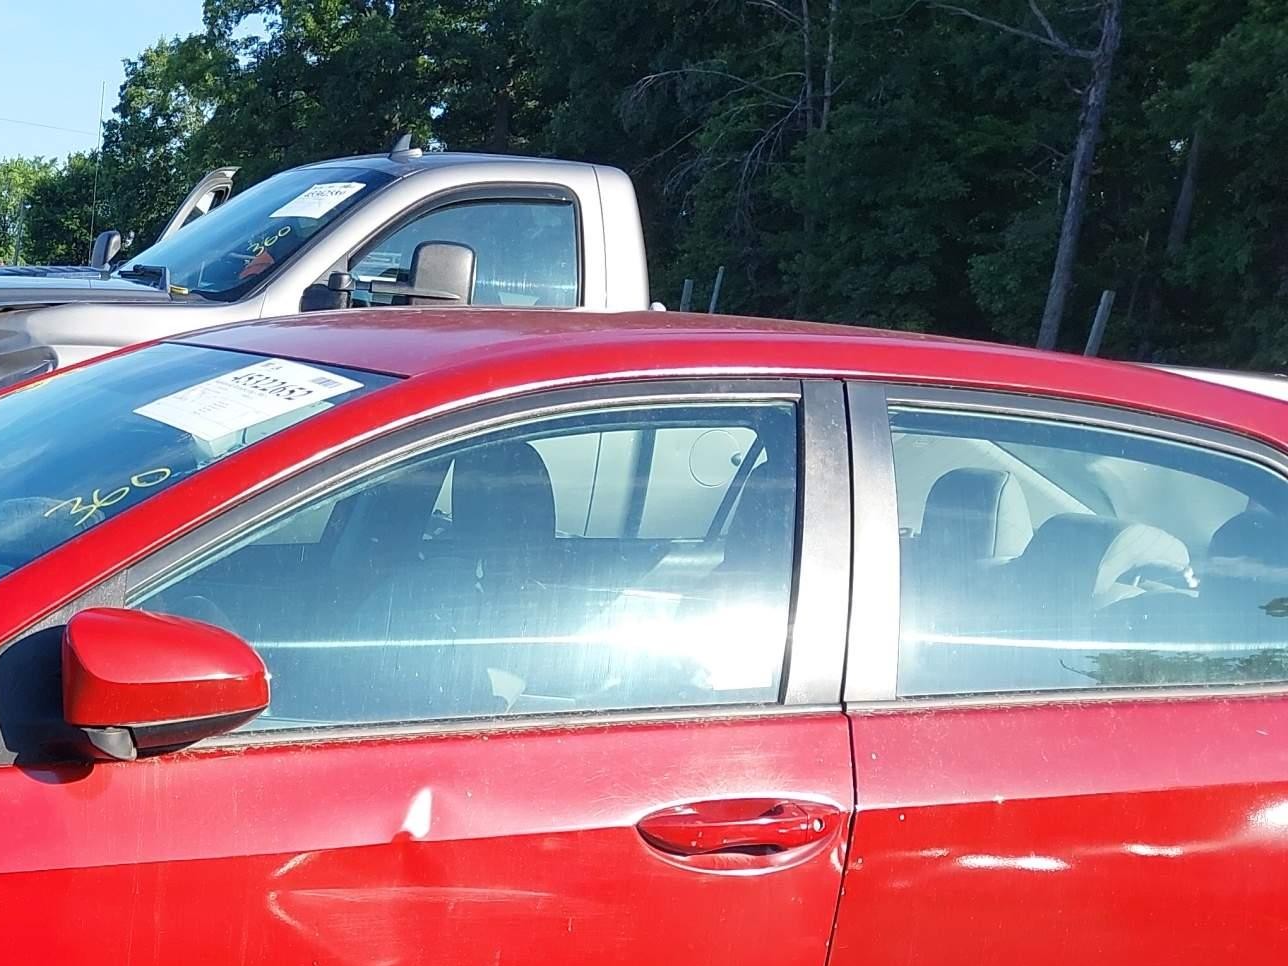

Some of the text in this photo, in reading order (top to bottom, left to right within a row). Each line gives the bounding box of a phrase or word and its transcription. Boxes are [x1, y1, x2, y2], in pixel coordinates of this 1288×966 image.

[245, 225, 292, 257] 360
[231, 372, 314, 401] 45322652
[42, 467, 172, 528] 360
